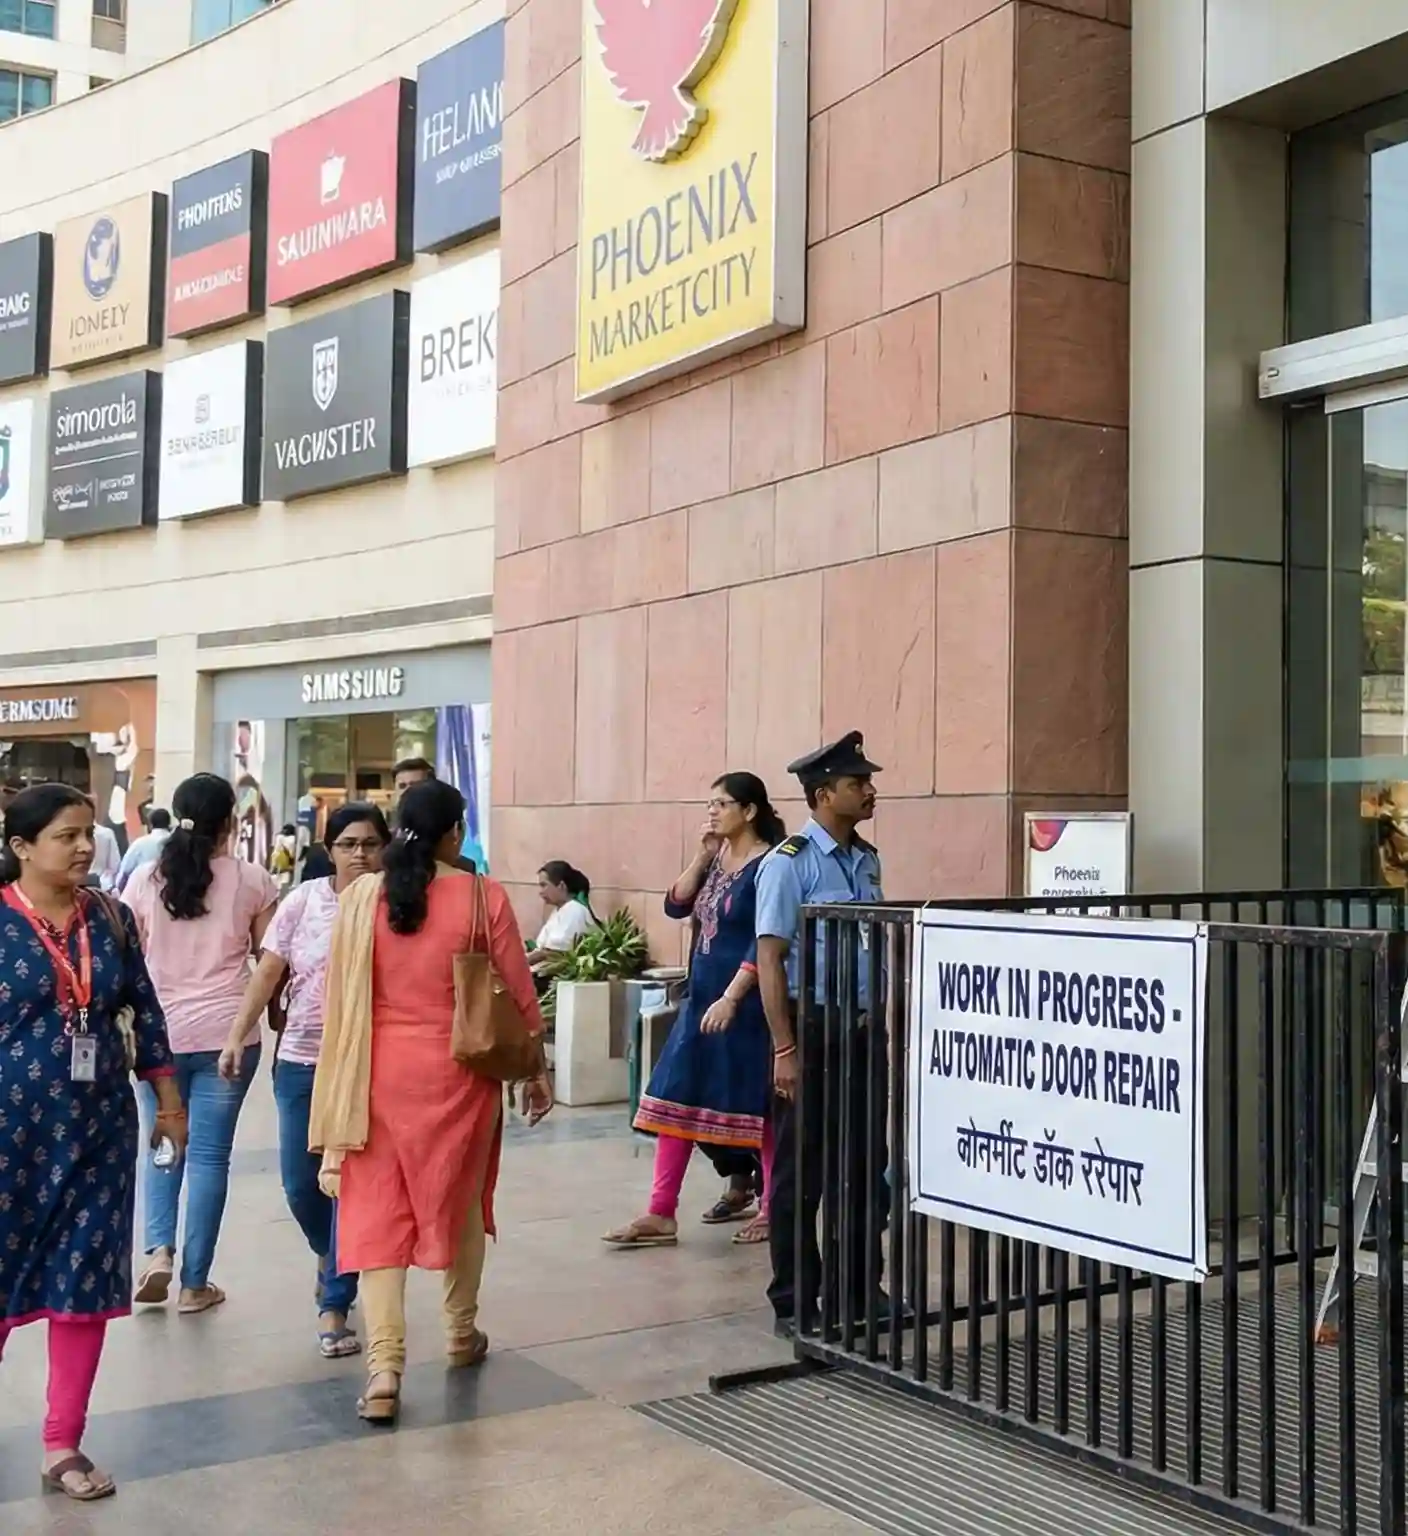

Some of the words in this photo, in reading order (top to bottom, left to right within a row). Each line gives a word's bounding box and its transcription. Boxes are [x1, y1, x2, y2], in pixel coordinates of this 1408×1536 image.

[591, 152, 758, 300] PHOENIX
[589, 247, 758, 363] MARKETCITY
[1054, 866, 1101, 881] Phoenix
[938, 961, 1001, 1016] WORK
[1008, 967, 1031, 1020] IN
[1037, 970, 1165, 1035] PROGRESS
[930, 1028, 1036, 1090] AUTOMATIC
[1041, 1042, 1098, 1100] DOOR
[1103, 1050, 1182, 1114] REPAIR
[1032, 1127, 1075, 1190] डॉक
